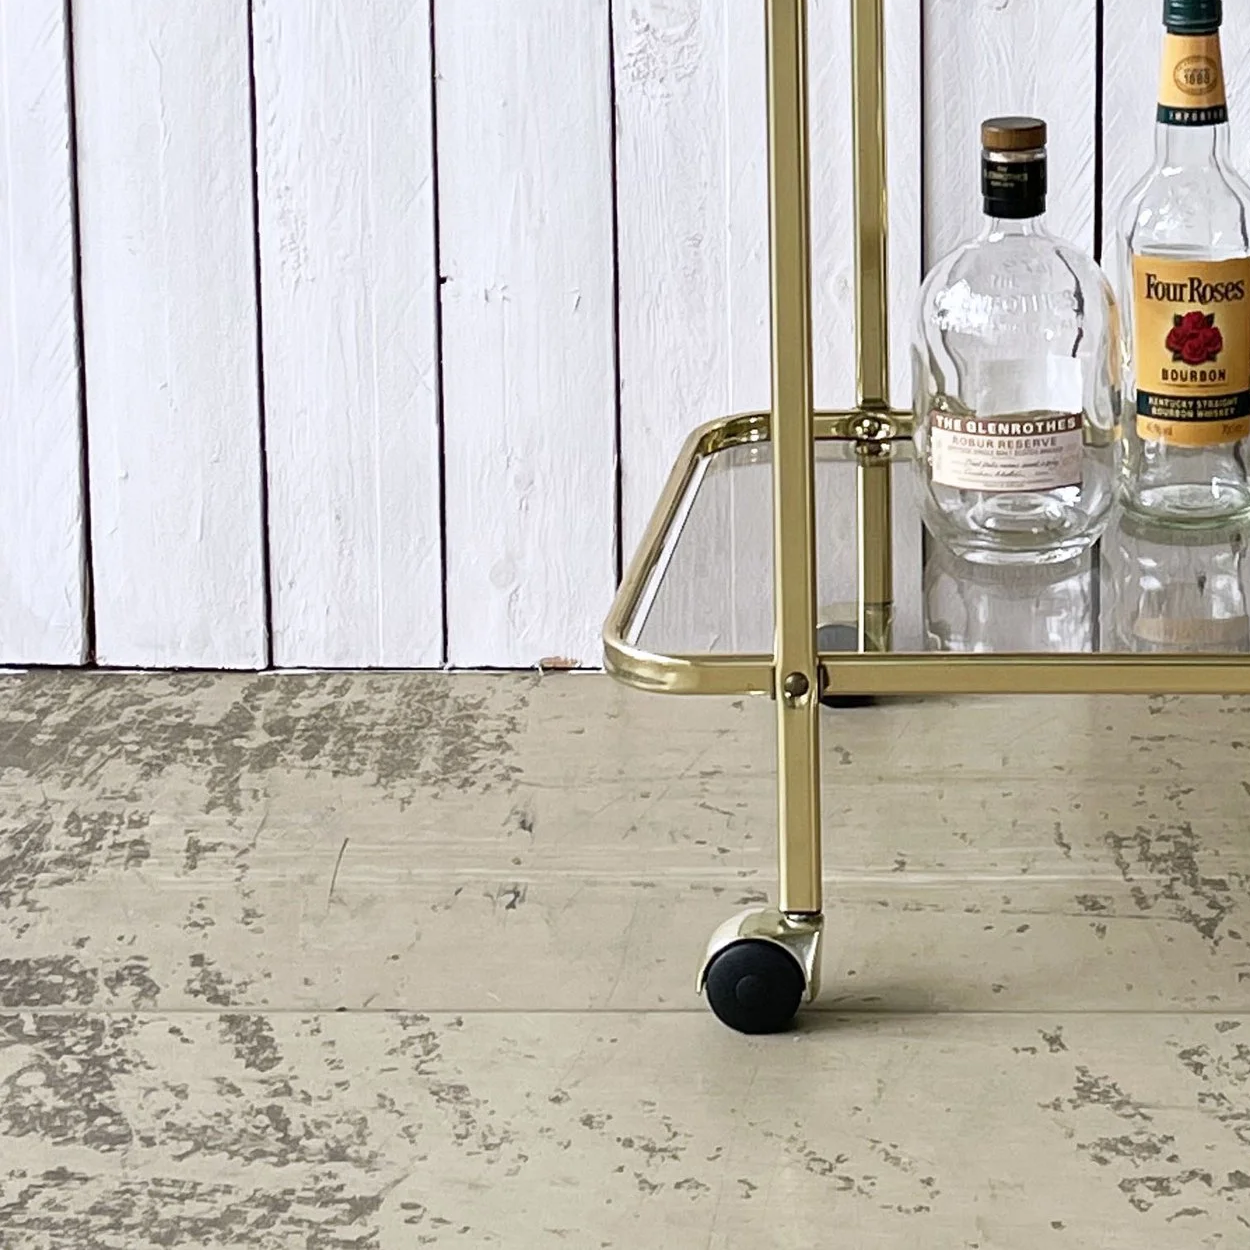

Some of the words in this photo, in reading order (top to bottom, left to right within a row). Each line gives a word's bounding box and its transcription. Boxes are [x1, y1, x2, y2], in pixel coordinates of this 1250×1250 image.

[1145, 272, 1188, 302] Four
[1188, 276, 1245, 305] Roses
[1161, 368, 1227, 382] BOURBON
[935, 414, 962, 432] THE
[966, 417, 1076, 435] GLENROTHES
[952, 435, 994, 449] ROBUR
[998, 436, 1058, 449] RESERVE
